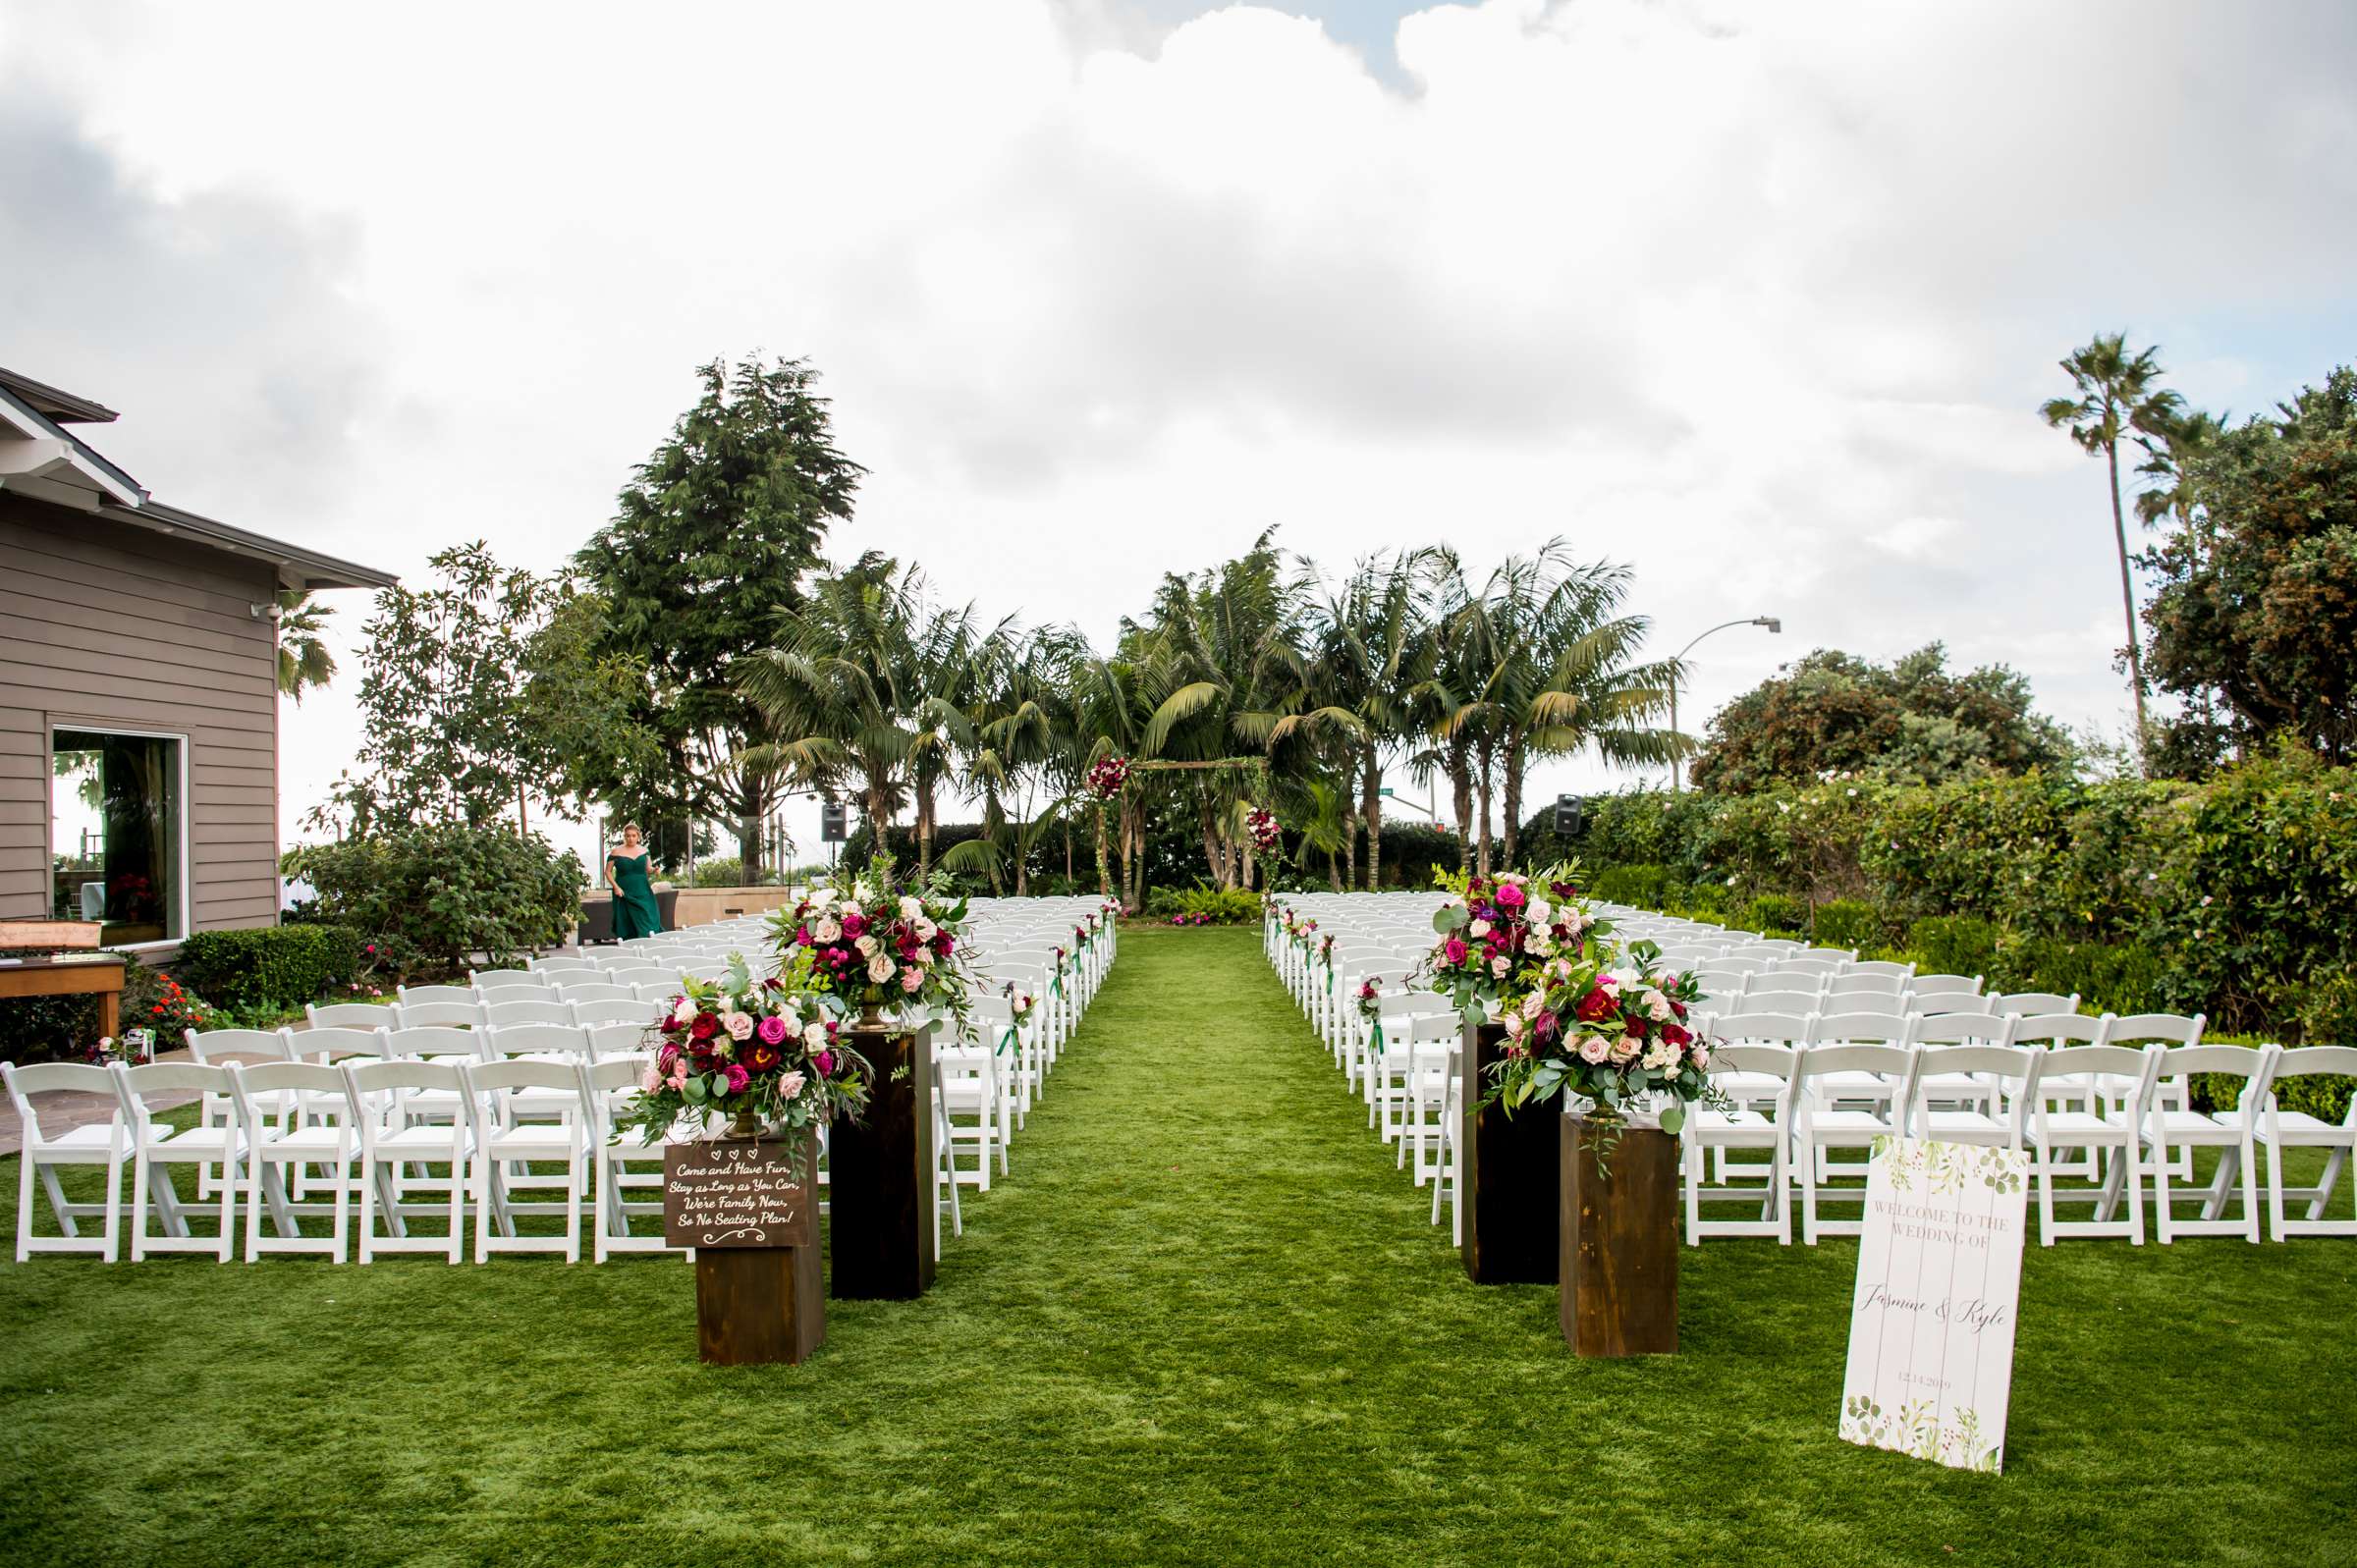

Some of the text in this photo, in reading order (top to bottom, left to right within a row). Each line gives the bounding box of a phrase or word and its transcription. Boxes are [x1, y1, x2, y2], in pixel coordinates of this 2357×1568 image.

[677, 1162, 791, 1176] Come and Have Fun,
[669, 1181, 693, 1194] Stay
[708, 1180, 735, 1193] Long
[752, 1179, 772, 1191] You
[775, 1178, 799, 1191] Can,
[718, 1195, 755, 1210] Family
[759, 1195, 788, 1208] Now,
[678, 1212, 794, 1226] So No Seating Plan!
[1874, 1200, 2009, 1232] WELCOME TO THE
[1891, 1221, 1991, 1249] WEDDING OF
[1857, 1283, 2010, 1334] Jasmine & Kyle
